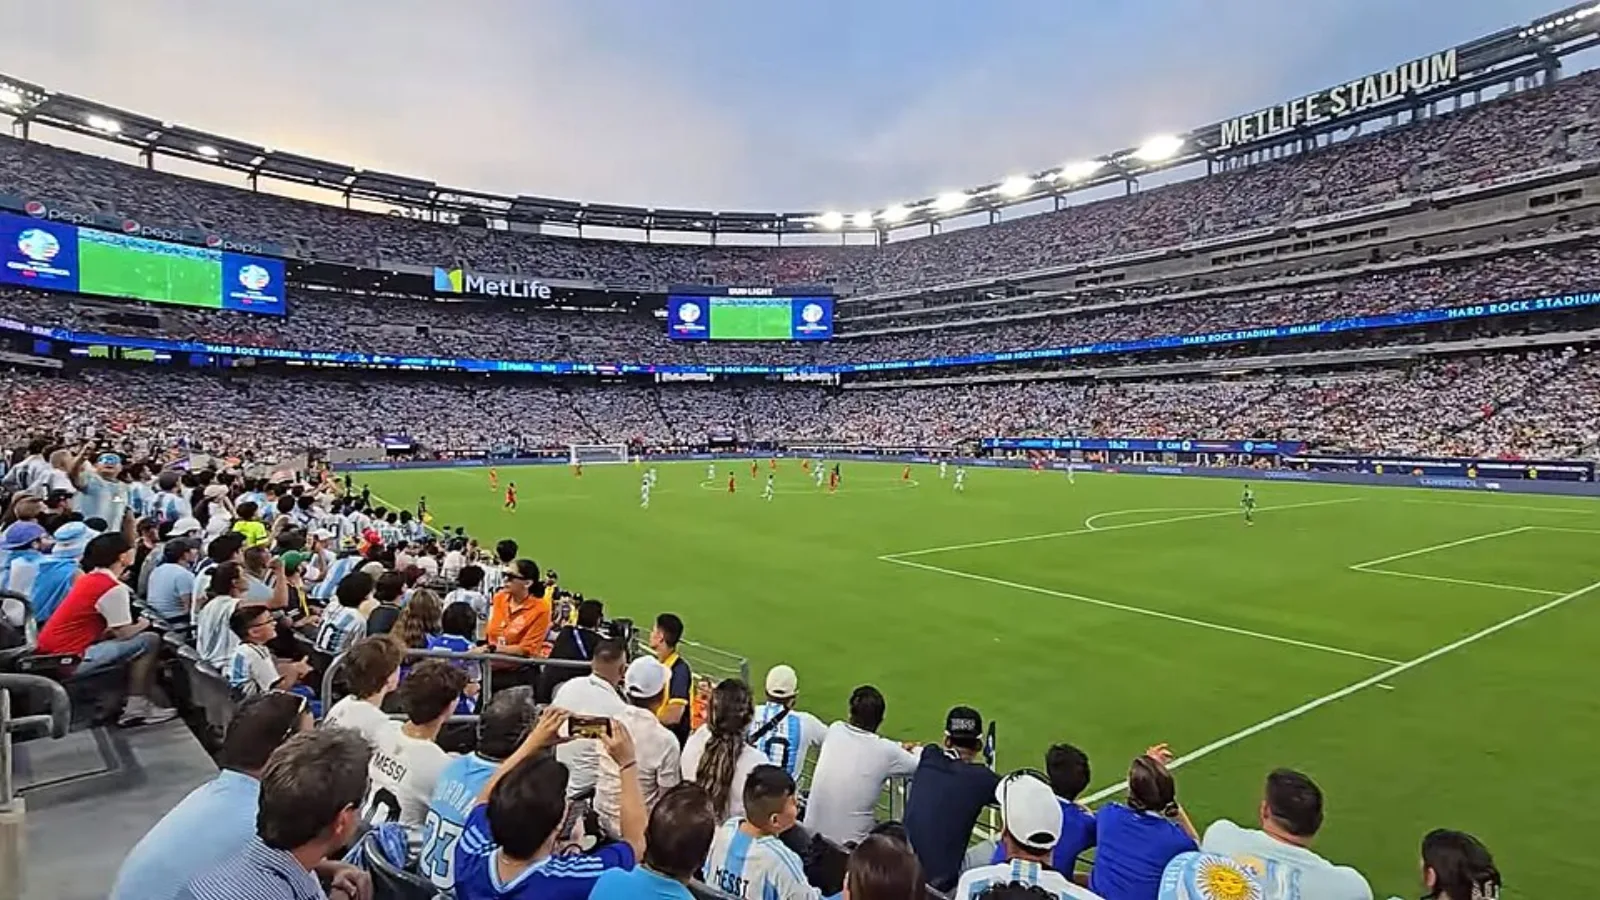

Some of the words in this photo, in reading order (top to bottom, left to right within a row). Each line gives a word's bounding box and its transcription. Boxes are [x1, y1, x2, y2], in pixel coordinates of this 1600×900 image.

[1221, 94, 1320, 147] METLIFE
[1329, 48, 1457, 114] STADIUM
[48, 209, 95, 224] pepsi
[465, 273, 551, 299] MetLife
[1449, 306, 1484, 318] HARD
[1490, 302, 1529, 313] ROCK
[1536, 294, 1600, 309] STADIUM
[1183, 335, 1206, 344] HARD
[1208, 333, 1233, 342] ROCK
[1236, 329, 1278, 339] STADIUM
[1289, 325, 1321, 334] MIAMI
[236, 346, 260, 355] ROCK
[373, 752, 407, 783] MESSI
[420, 808, 464, 890] 23
[713, 866, 749, 899] MESSI
